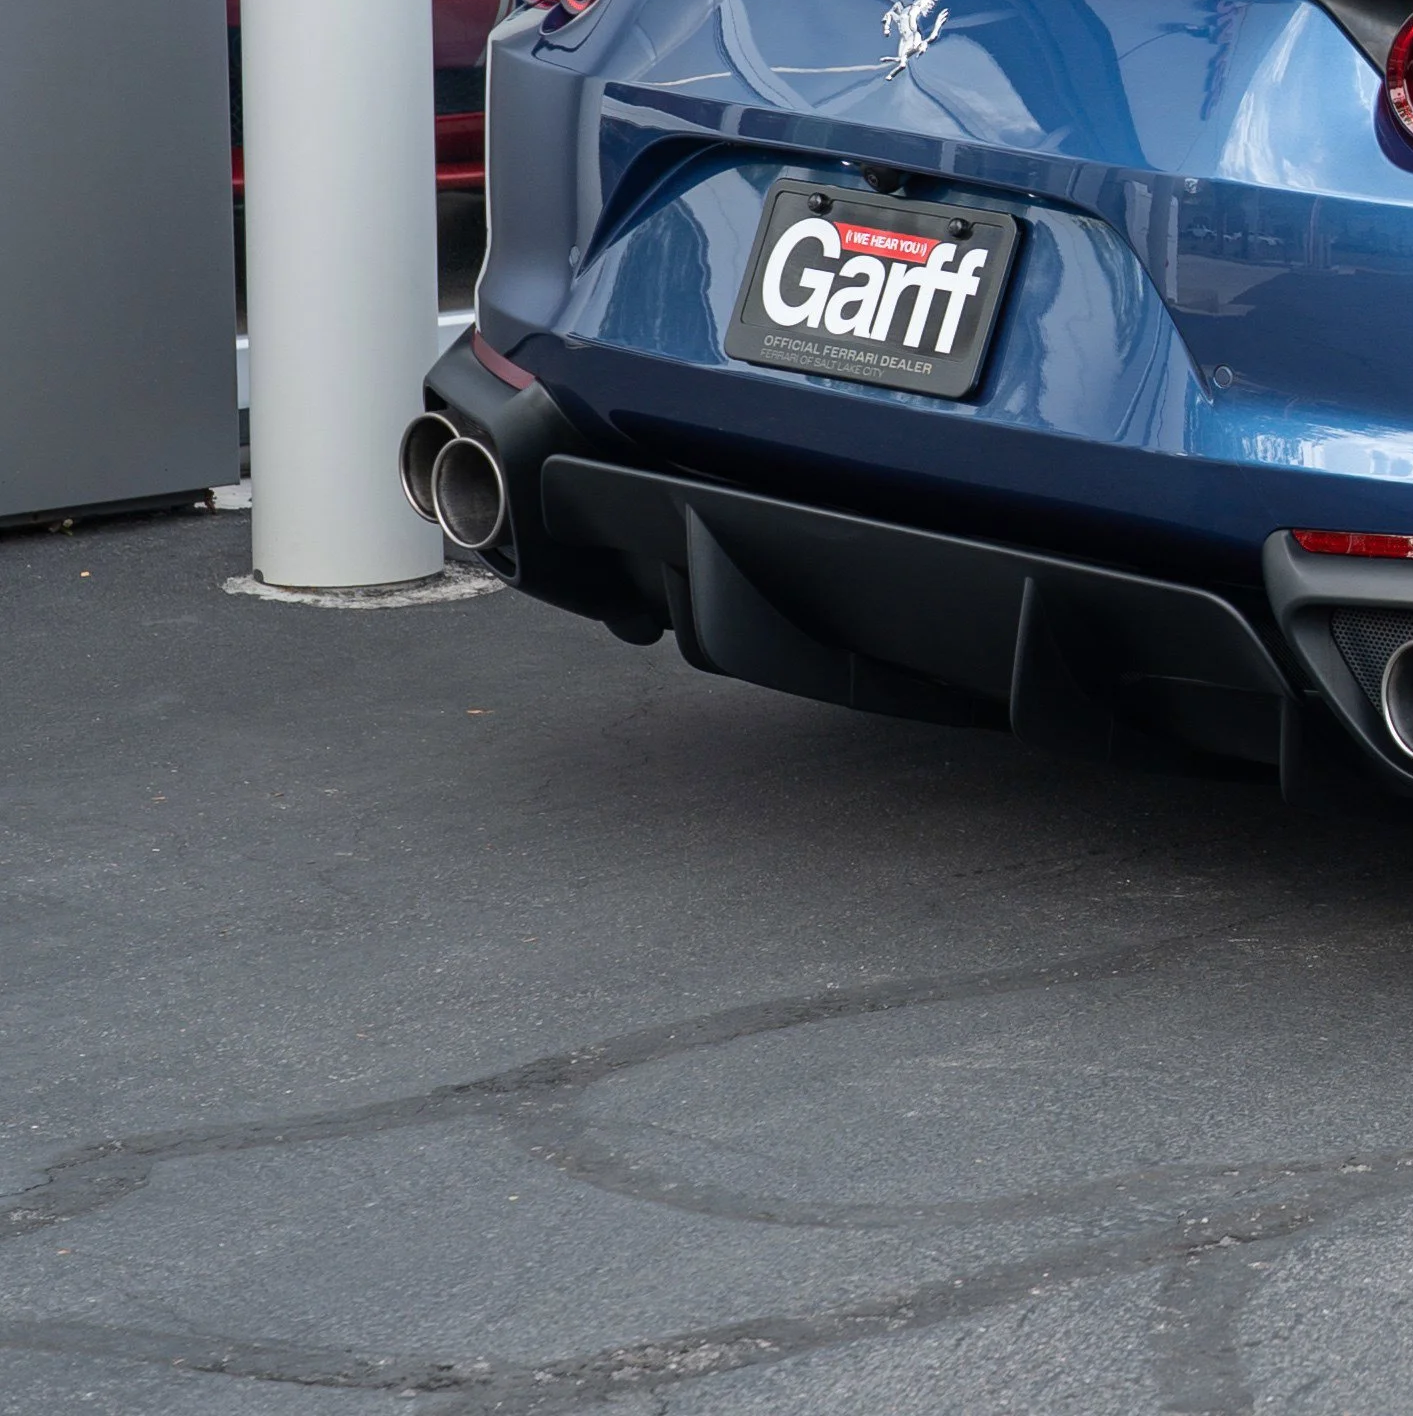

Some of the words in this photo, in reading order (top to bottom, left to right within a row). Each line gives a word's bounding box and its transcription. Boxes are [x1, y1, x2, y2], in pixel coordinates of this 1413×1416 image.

[853, 231, 871, 246] WE
[870, 234, 899, 251] HEAR
[899, 240, 920, 255] YOU
[761, 217, 989, 355] Garff
[760, 348, 800, 363] FERRARI
[800, 355, 813, 365] OF
[814, 357, 838, 370] SALT
[837, 361, 862, 375] LAKE
[862, 366, 886, 378] CITY
[763, 334, 821, 355] OFFICIAL
[822, 345, 879, 365] FERRARI
[880, 355, 933, 375] DEALER
